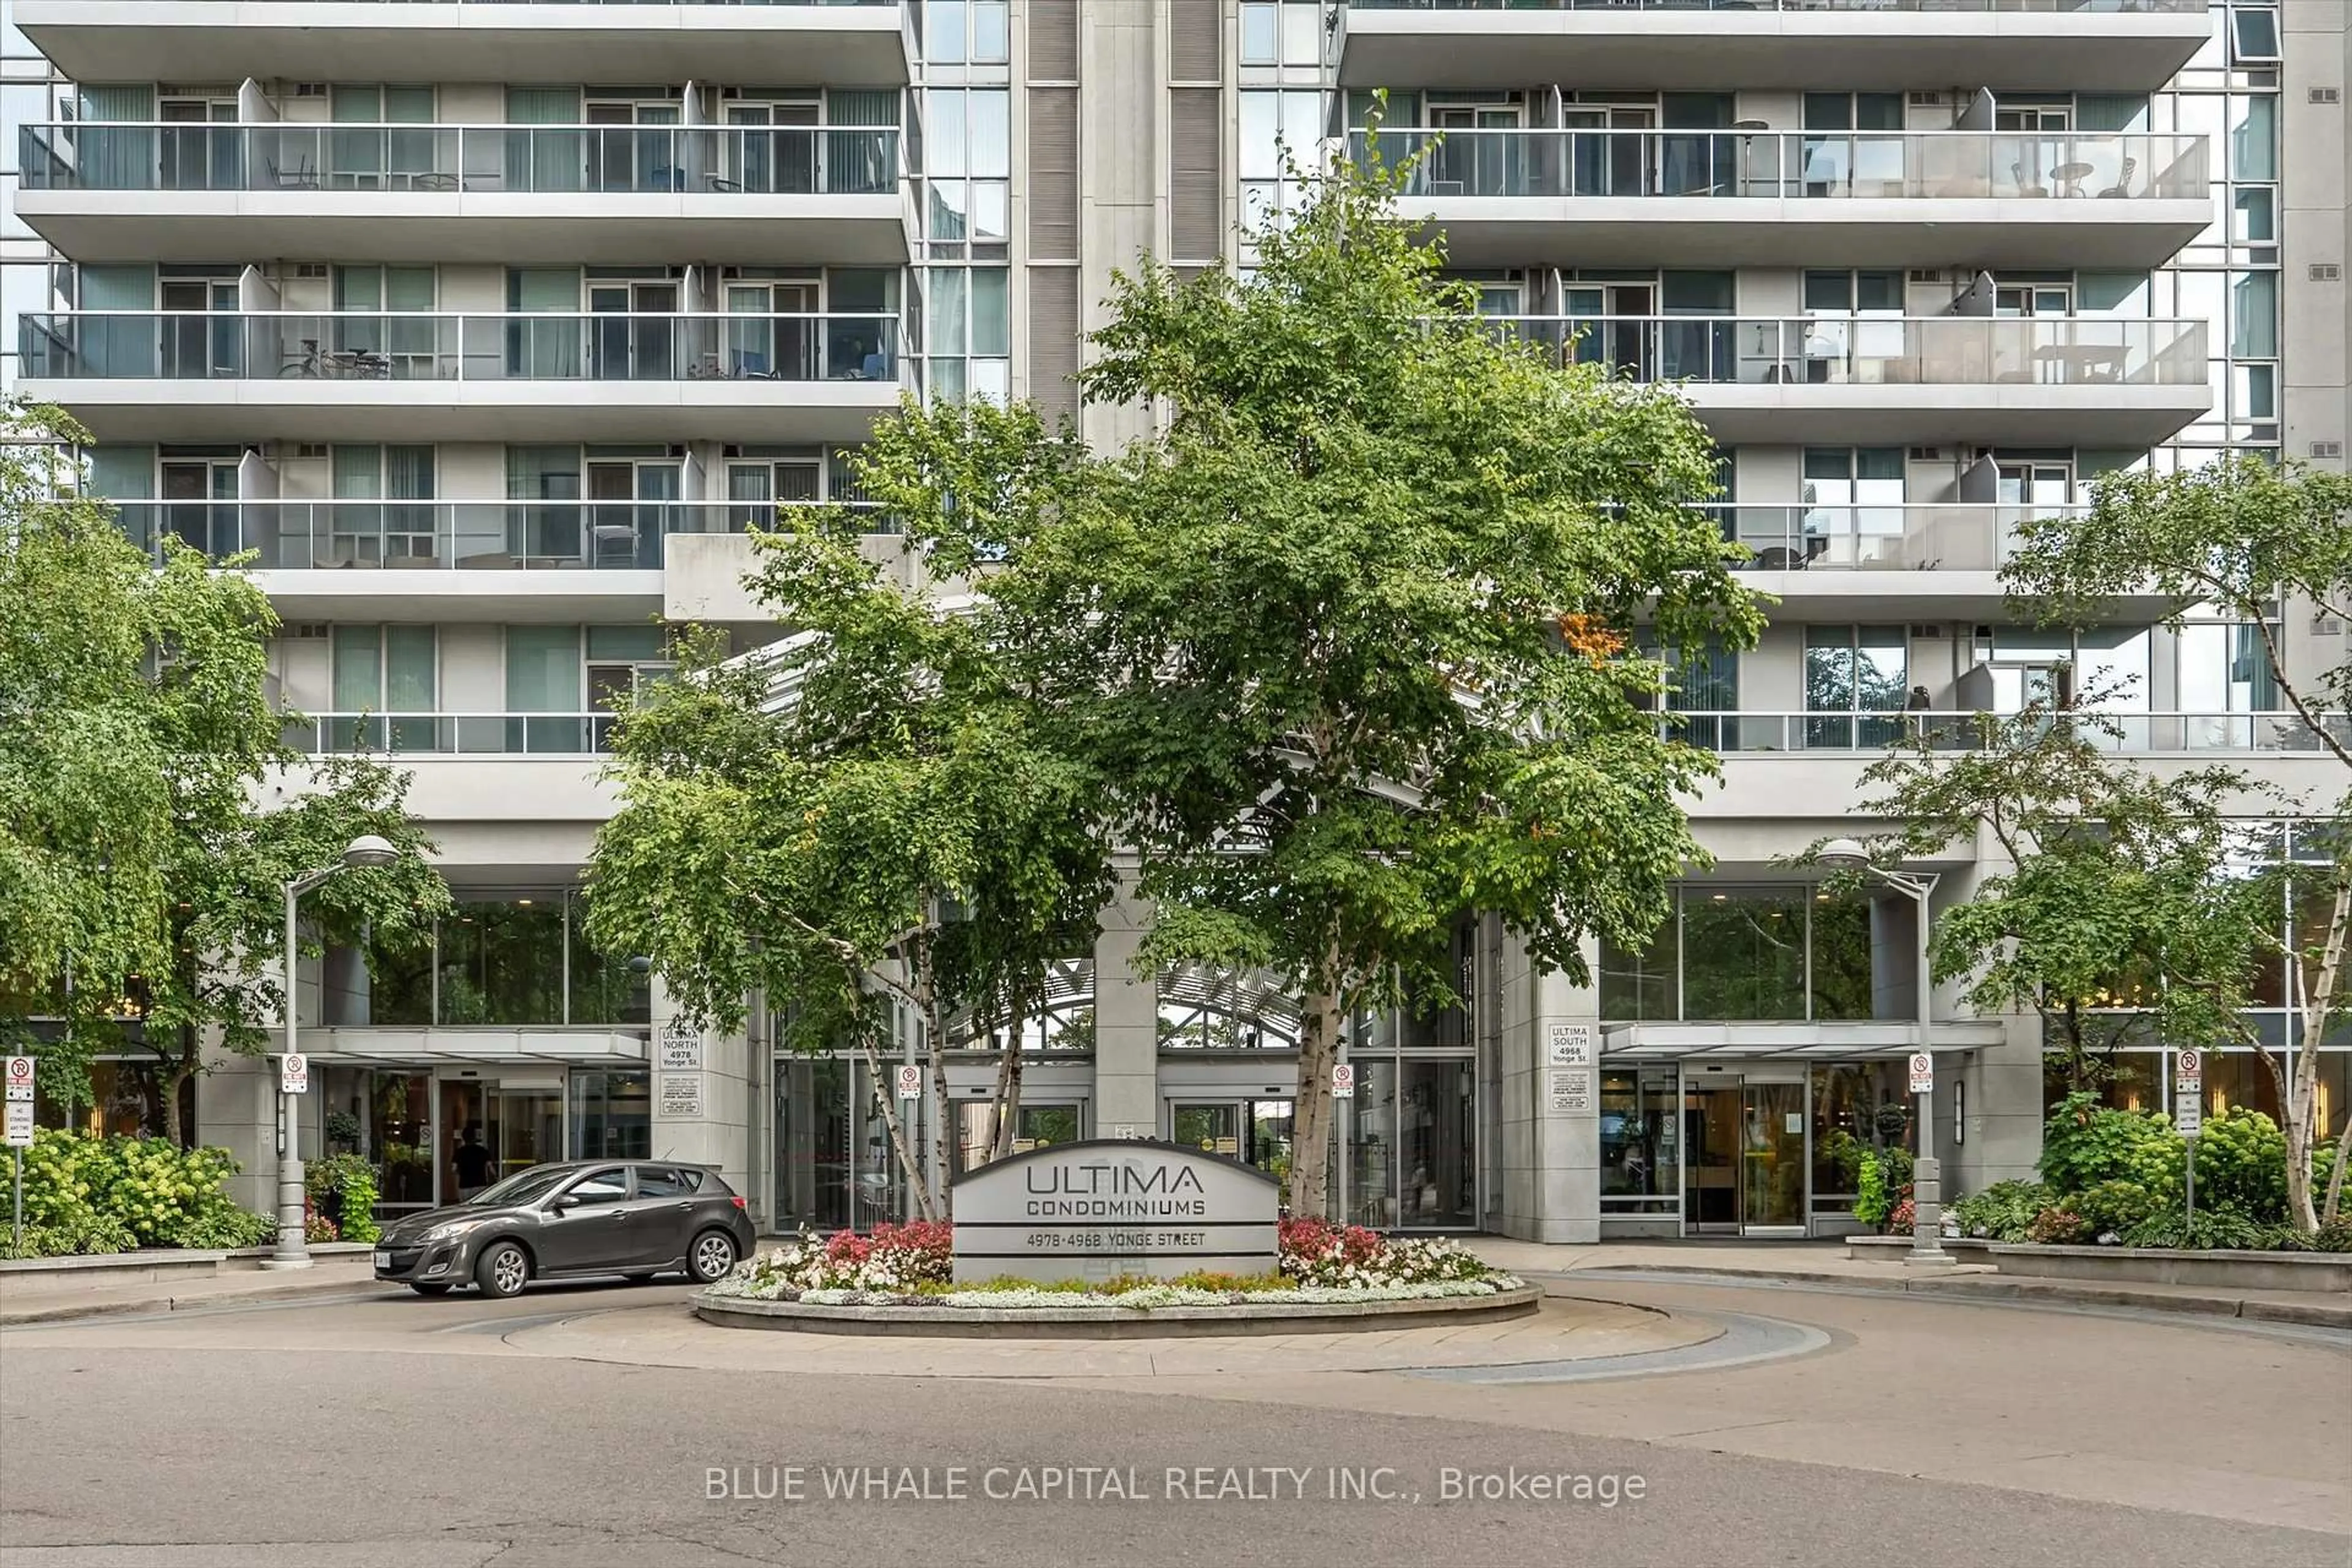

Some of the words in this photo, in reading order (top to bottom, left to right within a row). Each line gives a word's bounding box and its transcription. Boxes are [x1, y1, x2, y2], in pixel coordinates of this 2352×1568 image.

[663, 1030, 698, 1039] ULMA
[1553, 1027, 1587, 1036] ULTIMA
[664, 1041, 698, 1049] NORTH
[1553, 1037, 1587, 1046] SOUTH
[1027, 1166, 1204, 1194] ULTIMA
[1027, 1200, 1205, 1216] CONDOMINIUMS
[1108, 1233, 1153, 1247] YONGE
[1158, 1232, 1205, 1246] STREET
